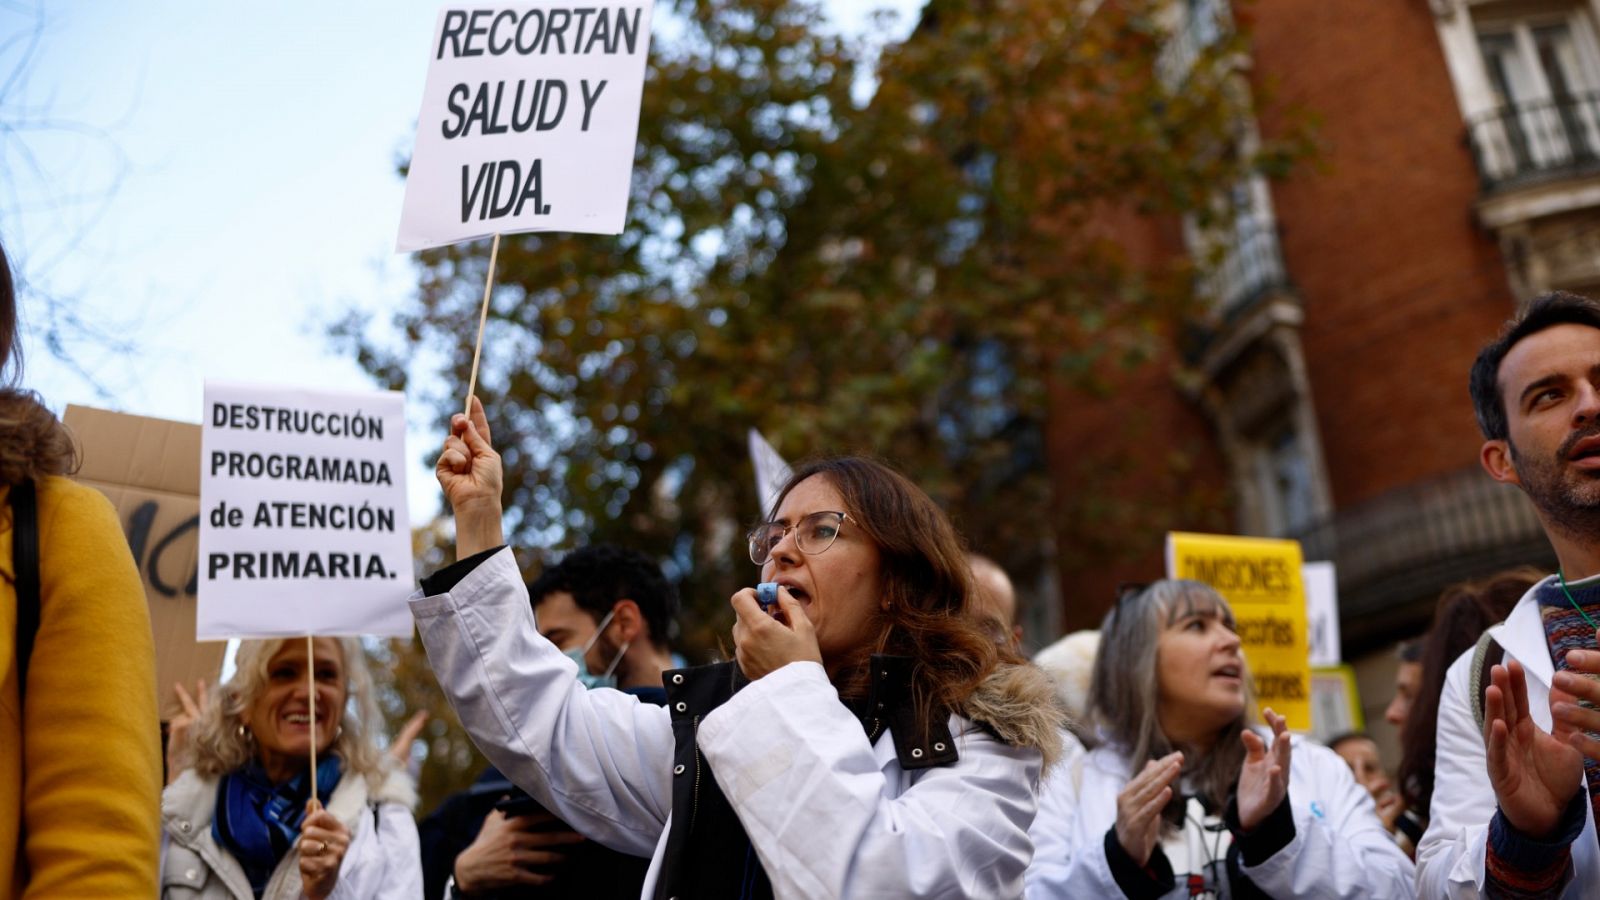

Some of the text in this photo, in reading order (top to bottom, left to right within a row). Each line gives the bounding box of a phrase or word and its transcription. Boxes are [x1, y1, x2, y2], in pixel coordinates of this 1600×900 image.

[436, 8, 641, 59] RECORTAN
[441, 79, 608, 139] SALUD Y
[461, 159, 551, 223] VIDA.
[212, 403, 384, 440] DESTRUCCIÓN
[210, 451, 392, 486] PROGRAMADA
[210, 500, 395, 533] de ATENCIÓN
[208, 552, 398, 580] PRIMARIA.
